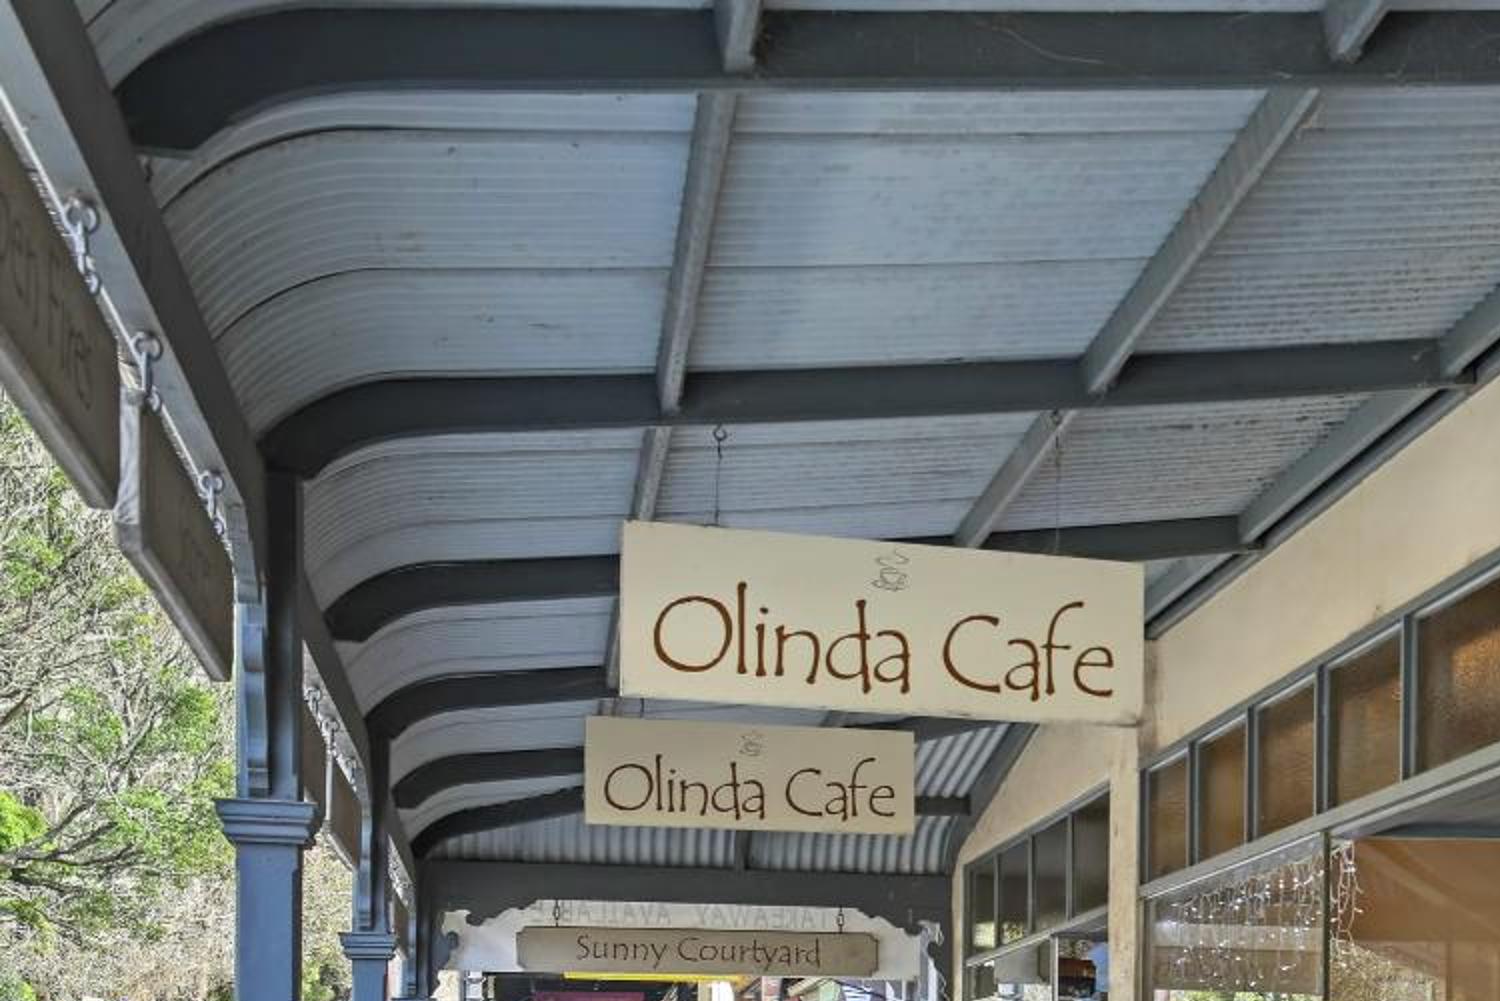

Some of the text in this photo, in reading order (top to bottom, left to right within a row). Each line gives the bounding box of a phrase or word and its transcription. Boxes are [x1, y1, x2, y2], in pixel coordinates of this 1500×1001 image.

[652, 581, 1114, 701] Olinda Cafe
[603, 753, 895, 822] Olinda Cafe
[576, 935, 821, 971] Sunny Courtyard
